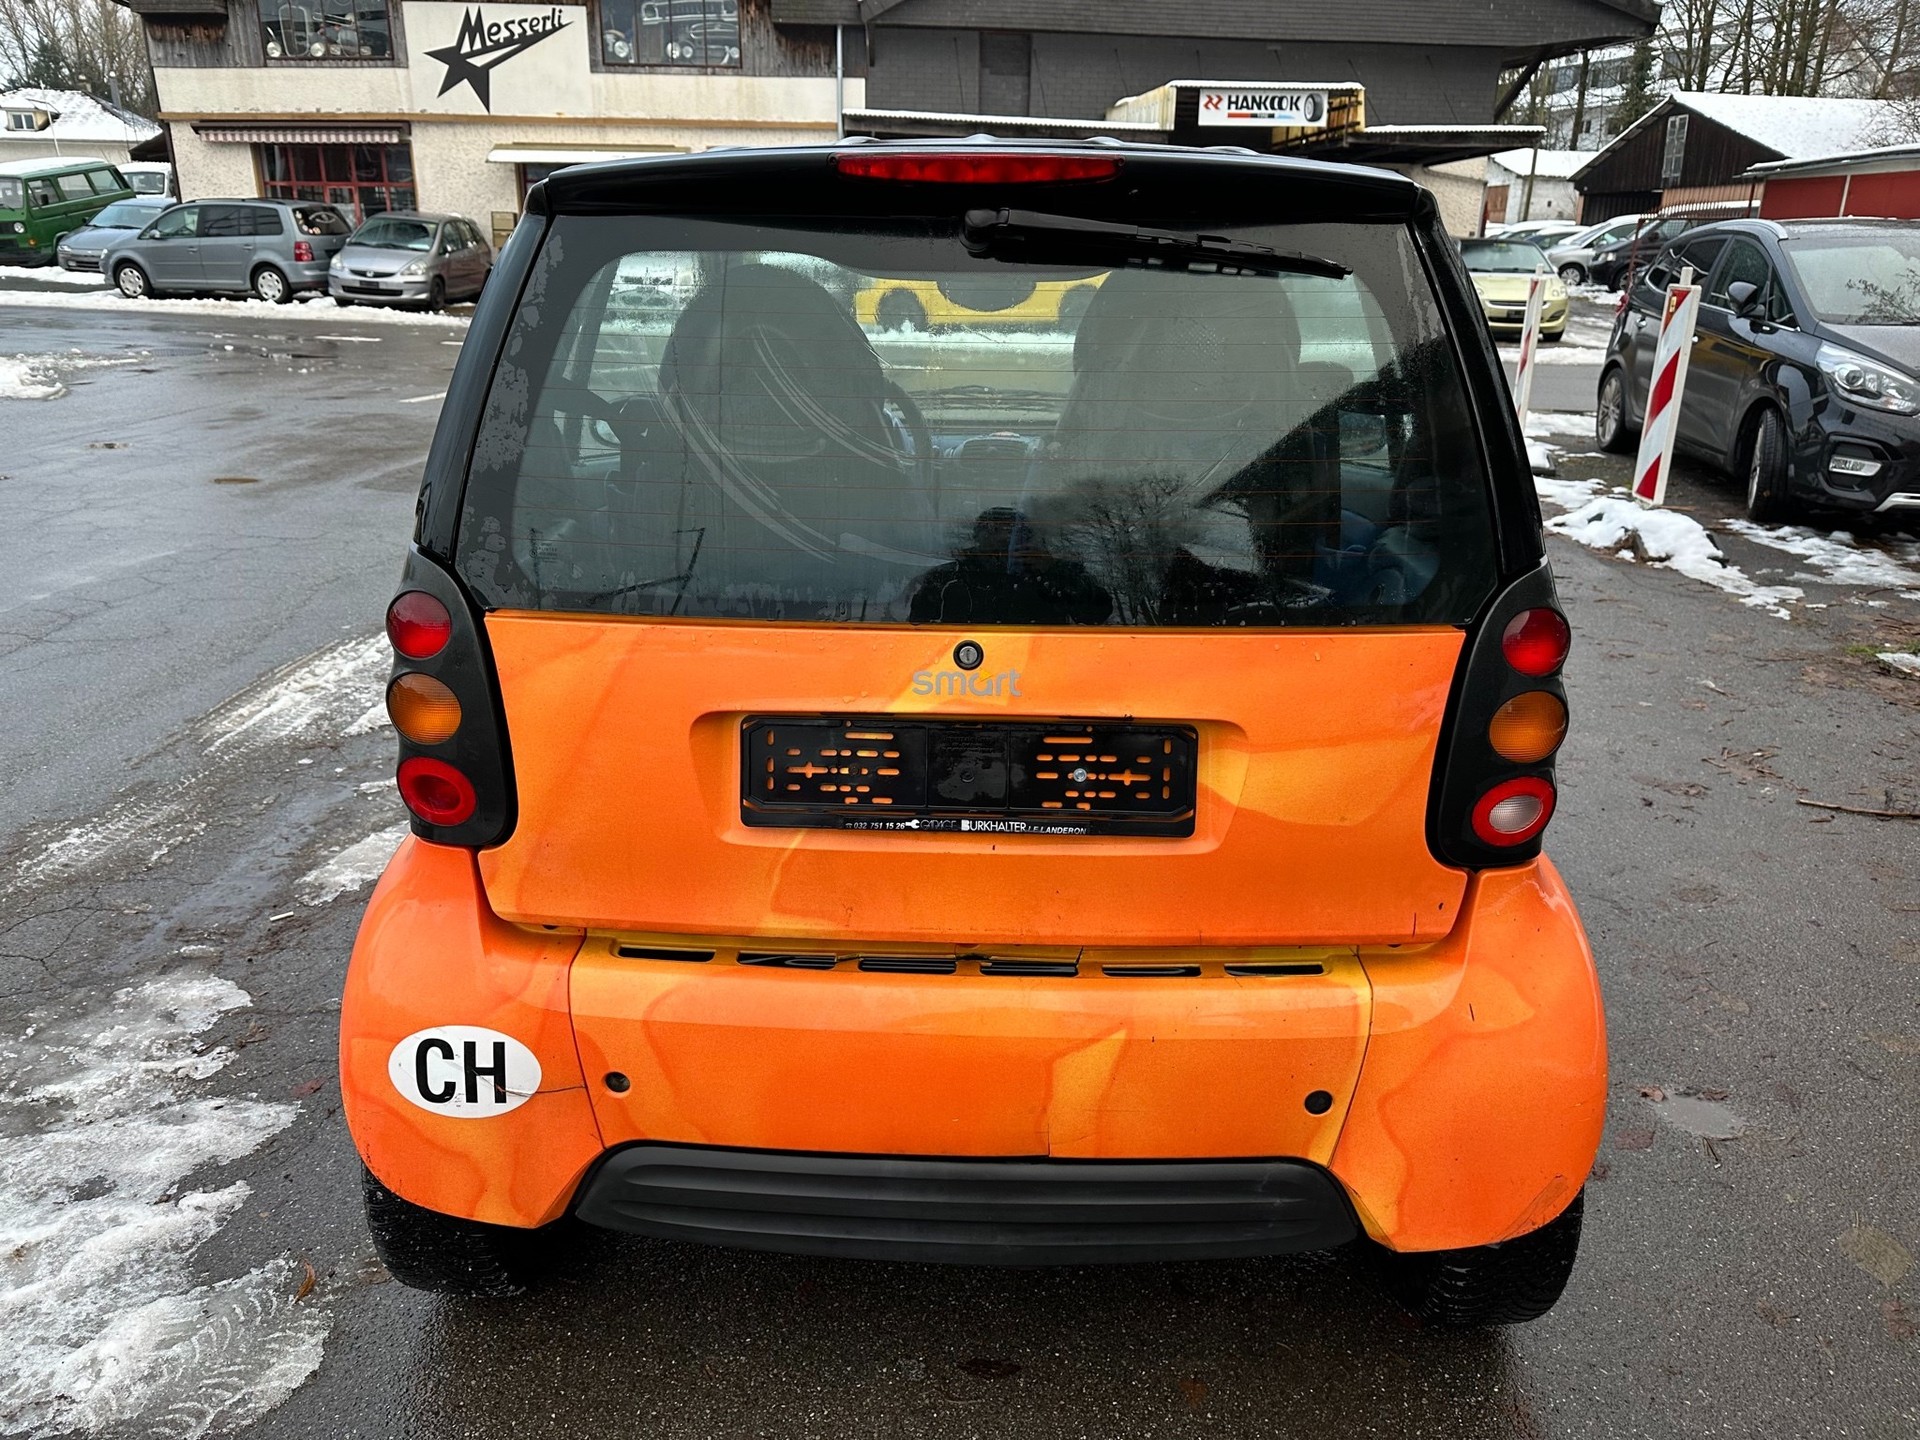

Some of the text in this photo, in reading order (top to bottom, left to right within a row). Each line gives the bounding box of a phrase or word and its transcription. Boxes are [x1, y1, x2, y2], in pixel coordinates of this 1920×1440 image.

[455, 5, 564, 53] Messerli
[1227, 95, 1301, 111] HANKOOK
[911, 668, 1022, 697] smart
[853, 822, 867, 830] 032
[870, 822, 883, 830] 751
[885, 822, 894, 830] 15
[895, 822, 905, 830] 26
[961, 819, 1027, 832] BURKHALTER
[1040, 825, 1087, 835] LANDERON
[415, 1038, 507, 1104] CH
